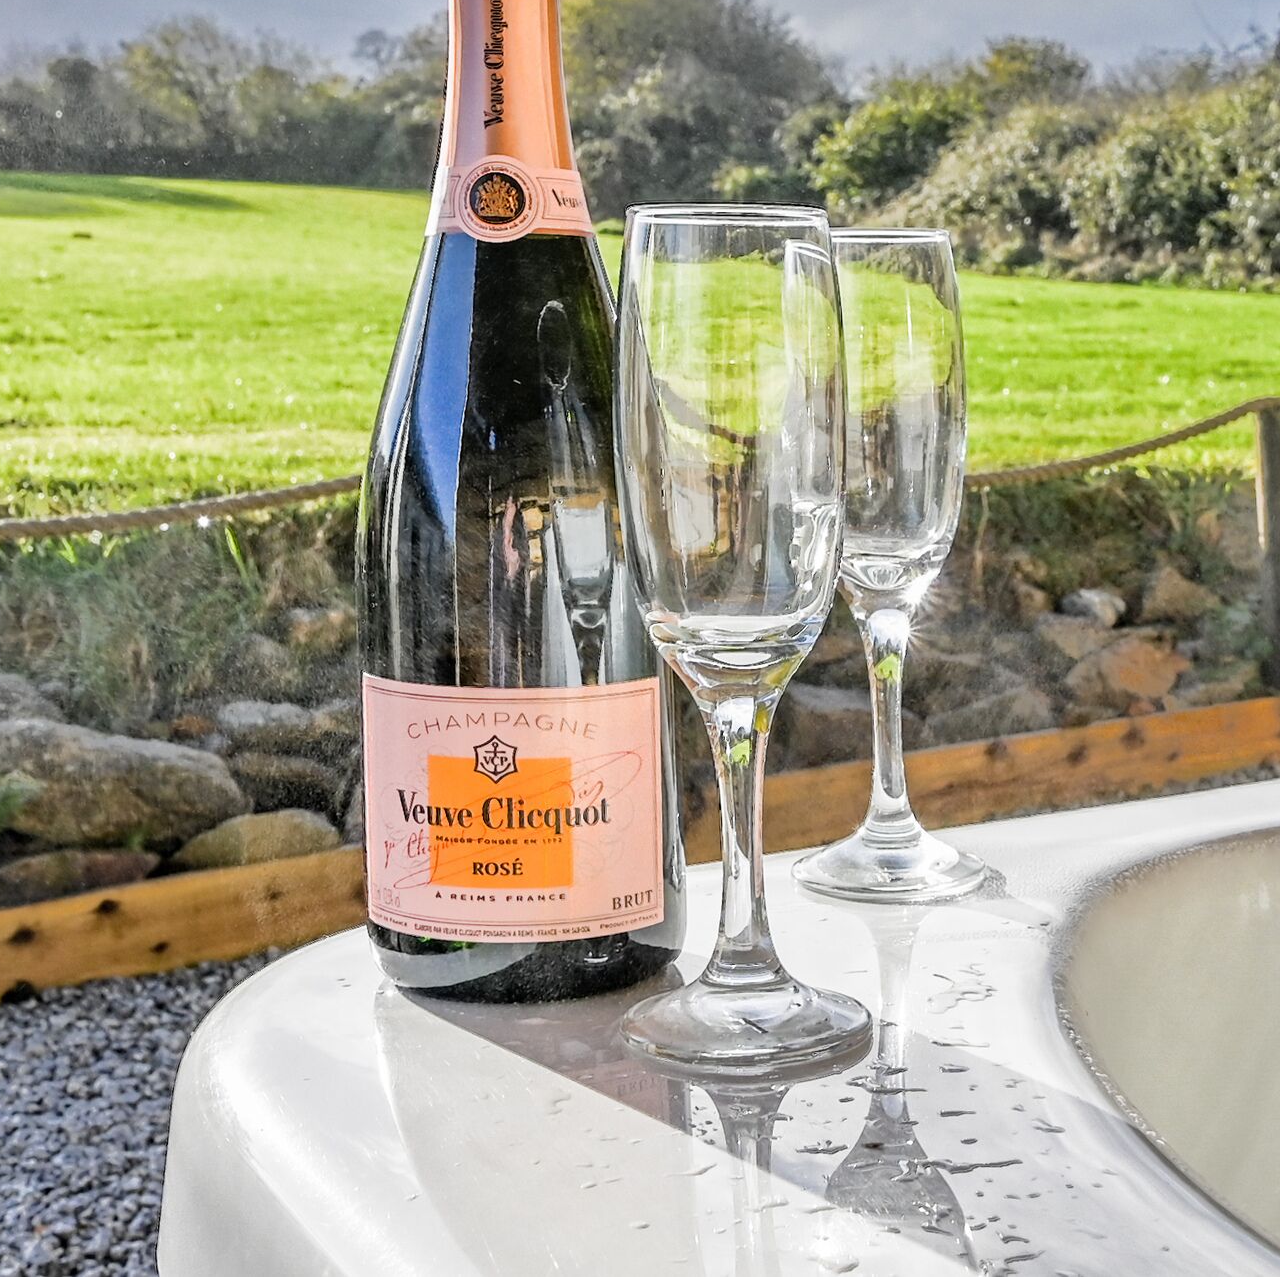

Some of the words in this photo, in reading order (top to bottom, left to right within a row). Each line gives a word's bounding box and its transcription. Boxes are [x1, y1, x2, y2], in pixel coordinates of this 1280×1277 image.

[483, 72, 505, 130] Veuve
[407, 712, 600, 740] CHAMPAGNE
[483, 755, 508, 767] VCP
[396, 788, 473, 829] Veuve
[481, 796, 611, 835] Clicquot
[472, 857, 524, 876] ROSÉ
[450, 893, 496, 902] REIMS
[505, 893, 566, 902] FRANCE
[612, 889, 653, 910] BRUT
